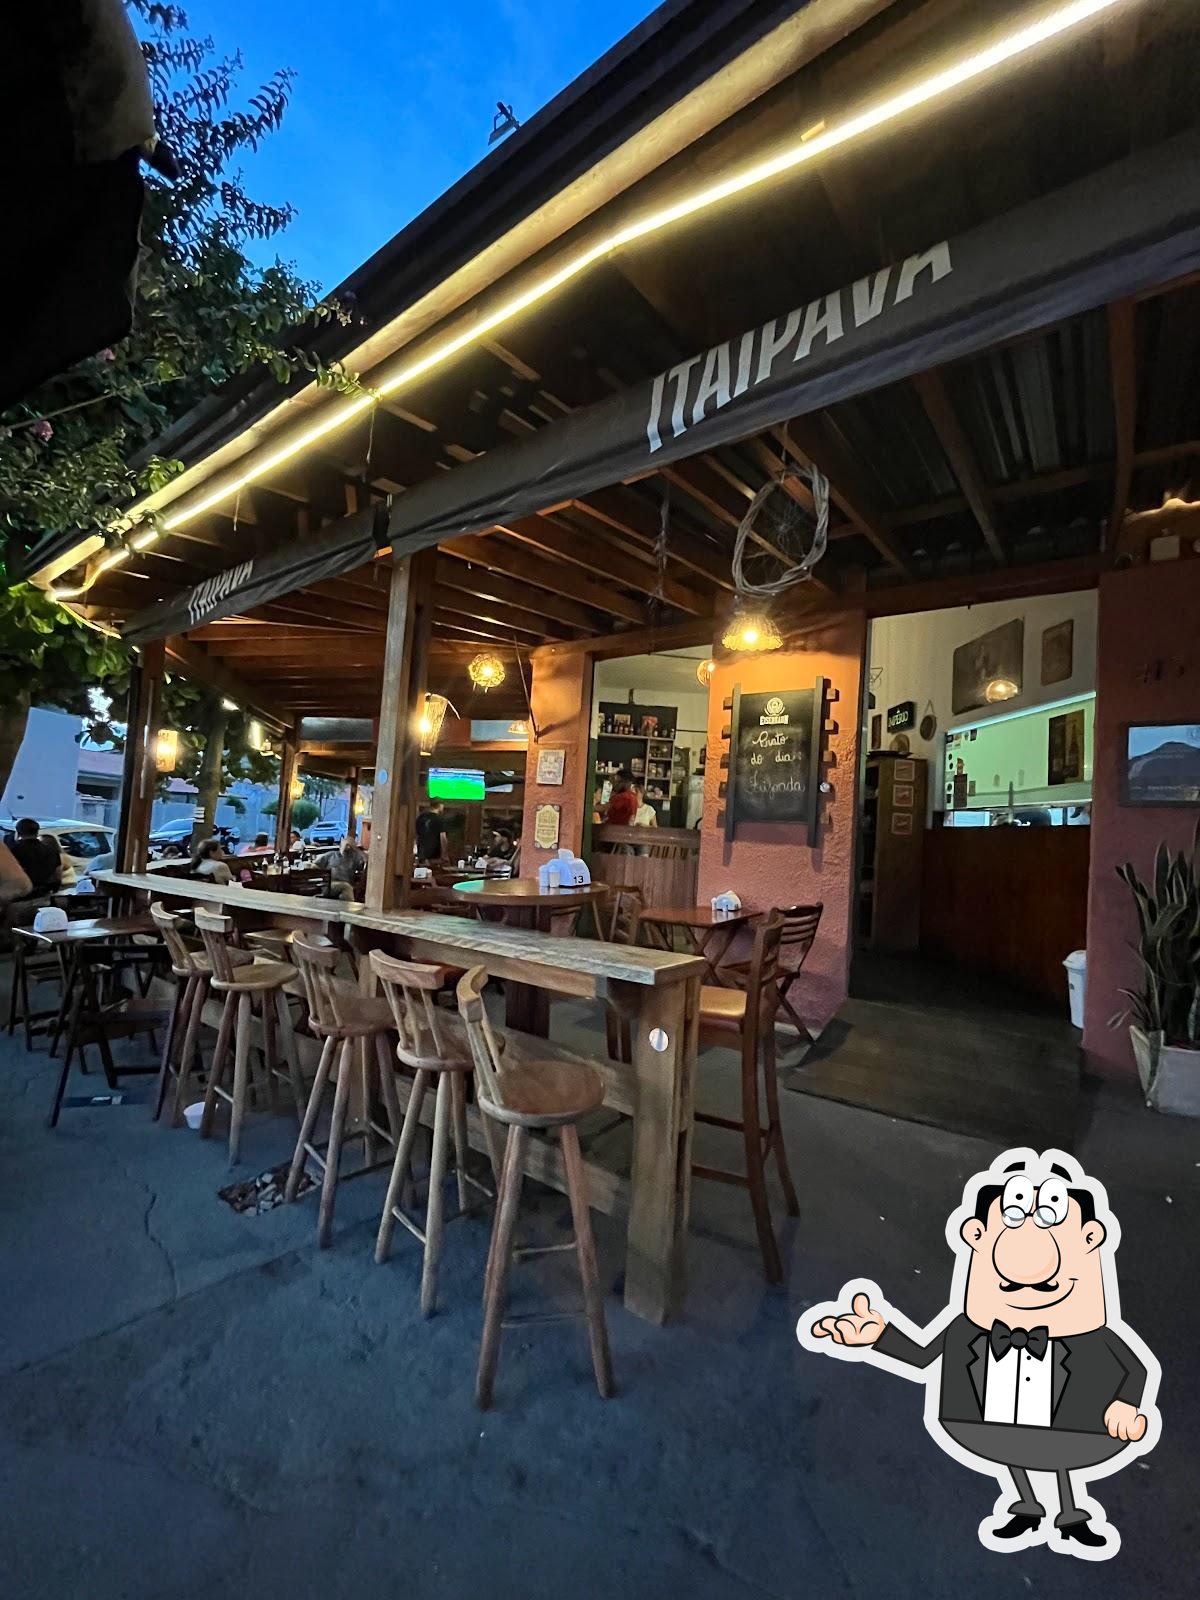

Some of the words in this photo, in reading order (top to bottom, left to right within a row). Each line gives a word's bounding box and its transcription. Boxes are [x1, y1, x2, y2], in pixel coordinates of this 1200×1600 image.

[187, 559, 254, 626] ITAIPAVA
[752, 730, 789, 748] Prato
[750, 751, 763, 765] do
[573, 875, 584, 884] 13
